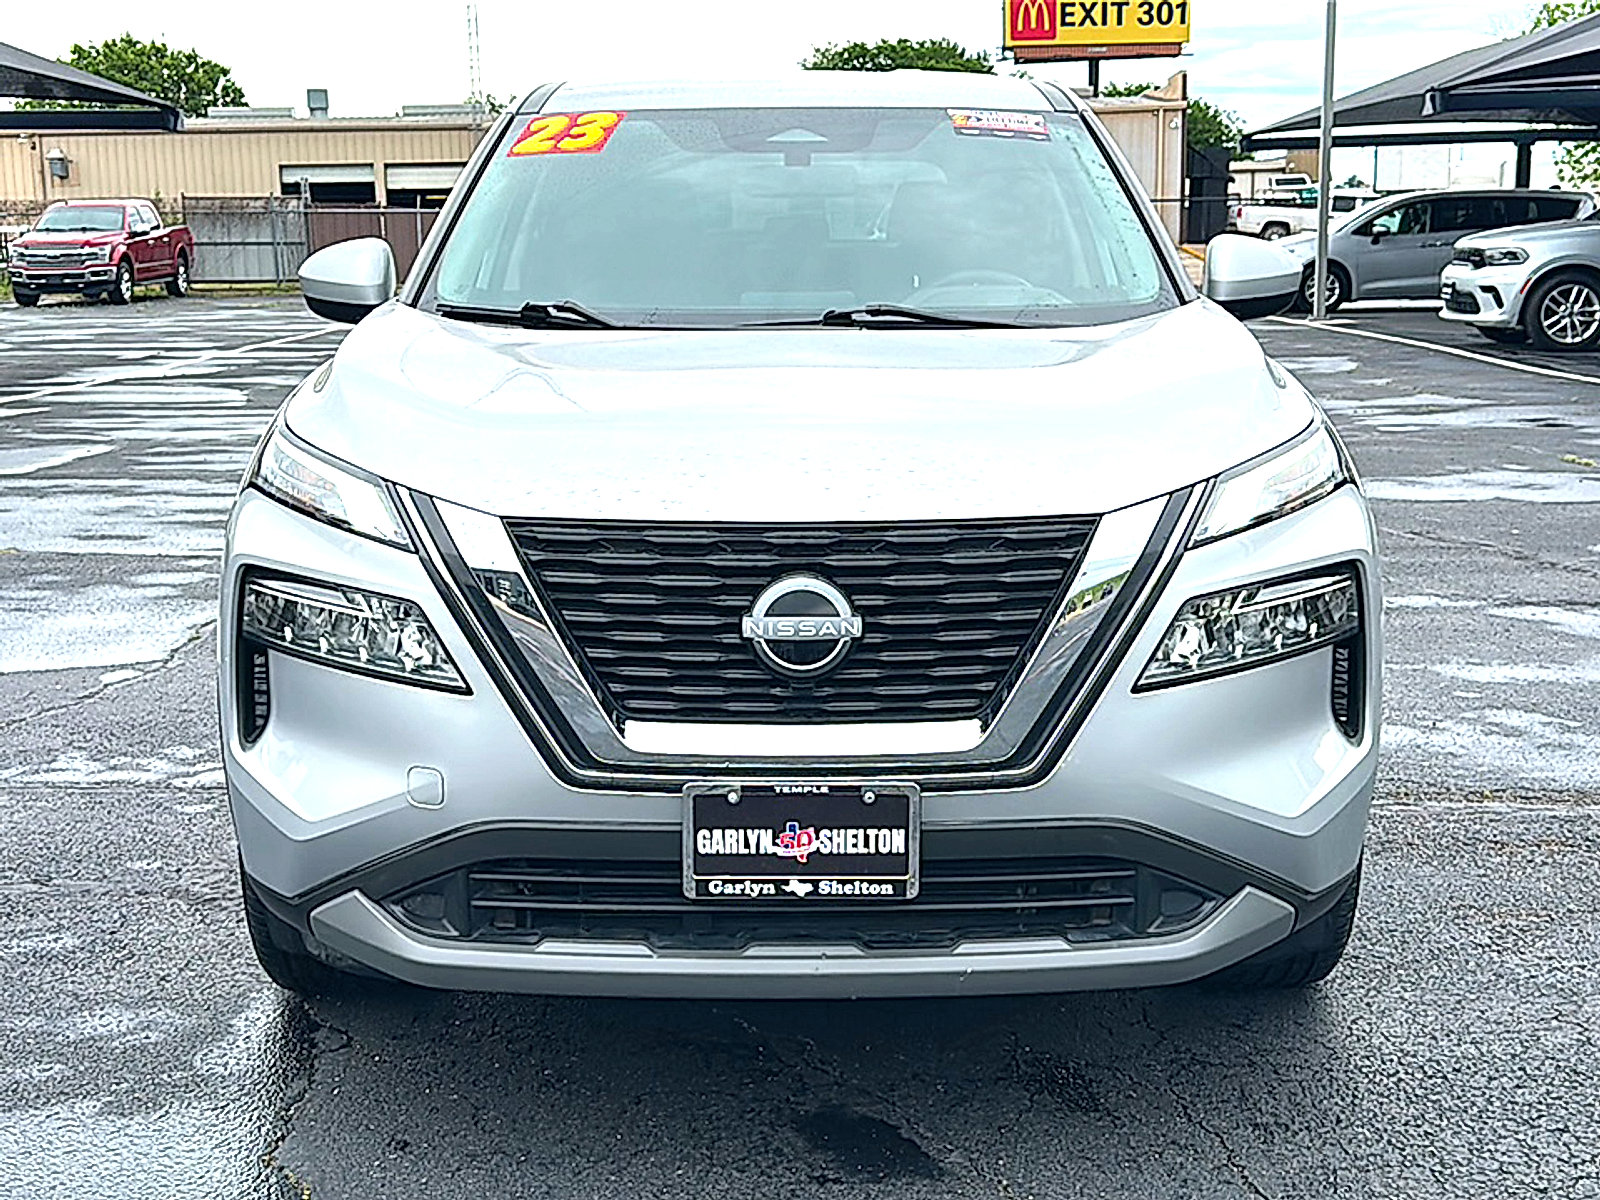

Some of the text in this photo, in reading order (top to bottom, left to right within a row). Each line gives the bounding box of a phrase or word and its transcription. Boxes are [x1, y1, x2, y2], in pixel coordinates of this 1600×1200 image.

[1060, 2, 1130, 26] EXIT
[1137, 1, 1187, 26] 301
[512, 113, 618, 153] 23
[745, 621, 858, 636] NISSAN
[774, 786, 829, 794] TEMPLE
[697, 829, 774, 854] GARLYN
[820, 829, 906, 854] SHELTON
[709, 881, 894, 897] Garlyn Shelton
